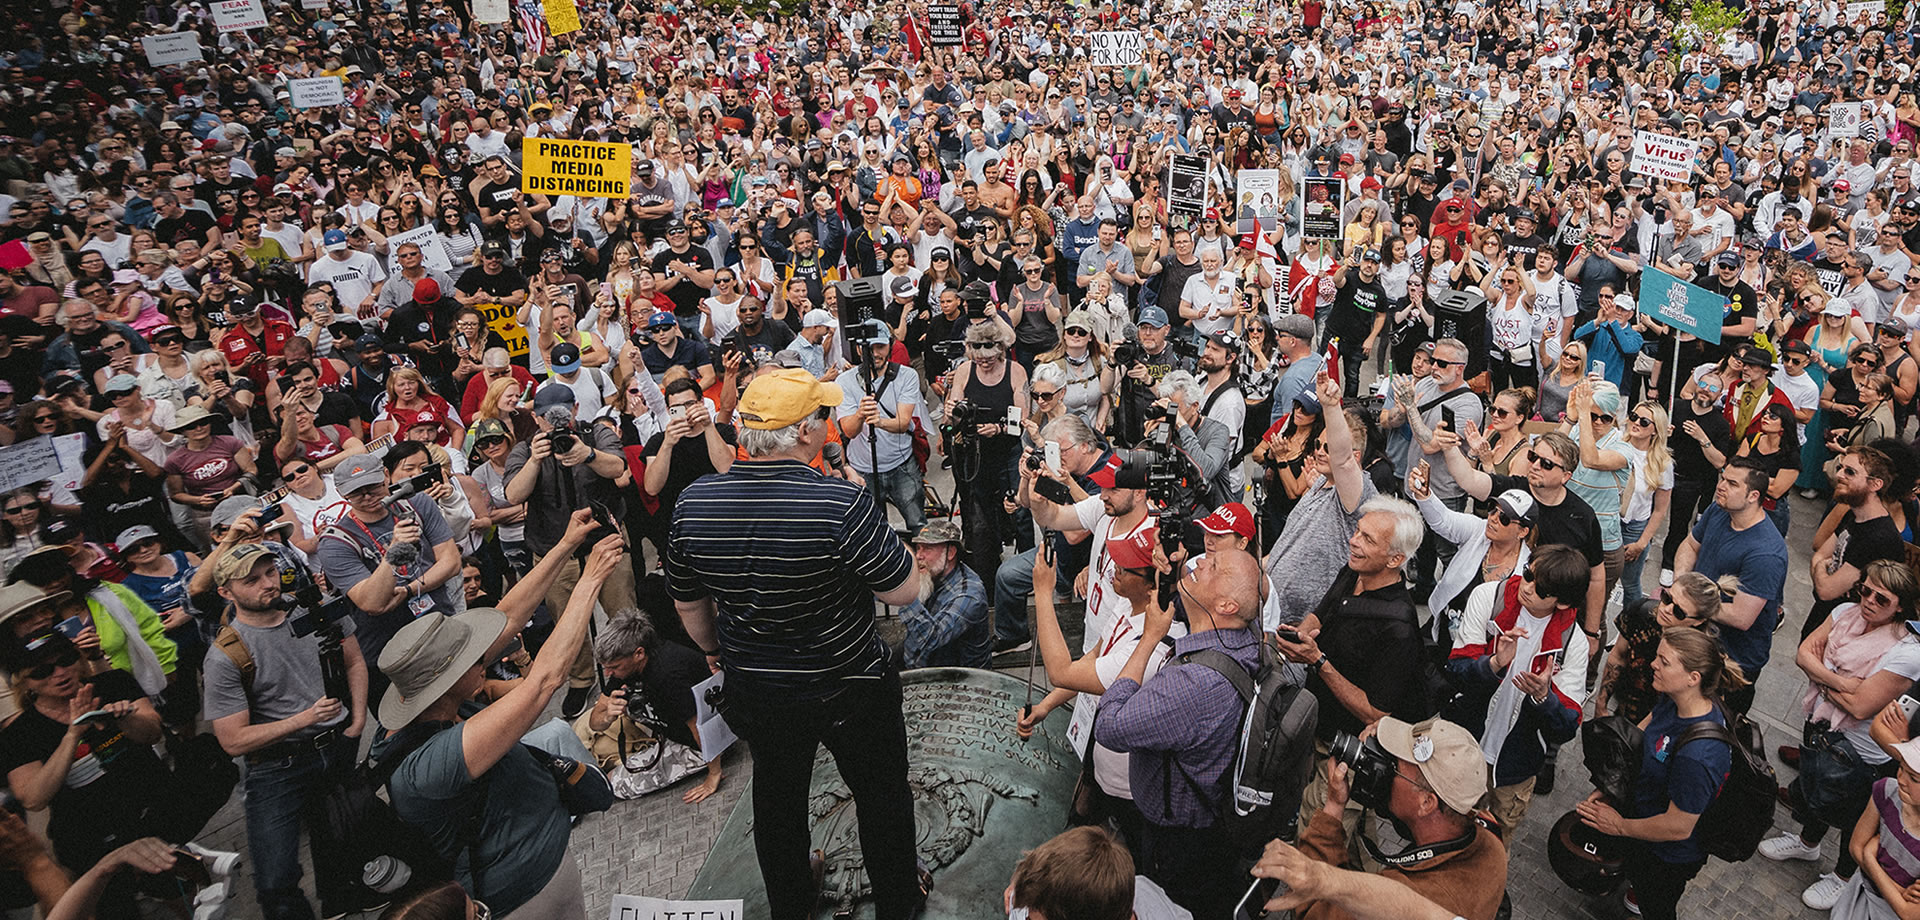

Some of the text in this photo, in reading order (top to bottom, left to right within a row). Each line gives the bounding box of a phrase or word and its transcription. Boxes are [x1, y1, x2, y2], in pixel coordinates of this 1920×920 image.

[222, 0, 250, 9] FEAR
[219, 20, 265, 31] TERRORISTS
[1092, 33, 1140, 48] NO VAX
[1092, 49, 1142, 65] FOR KIDS
[301, 91, 338, 99] DEMOCRACY
[1644, 134, 1658, 142] it's
[1676, 139, 1690, 149] the
[540, 143, 617, 161] PRACTICE
[1635, 154, 1646, 162] they
[1645, 143, 1686, 162] Virus
[551, 161, 604, 177] MEDIA
[1640, 164, 1679, 179] It's You!
[529, 177, 624, 194] DISTANCING
[333, 272, 359, 283] PUMA
[1673, 282, 1686, 293] We
[1668, 289, 1689, 304] Want
[1669, 299, 1684, 311] Our
[1659, 304, 1697, 327] Freedom!
[1496, 319, 1521, 329] JUST
[1496, 331, 1520, 339] SAY
[194, 462, 225, 480] Pepper
[264, 492, 278, 504] TO
[918, 711, 1021, 737] EMPEROR
[931, 726, 1025, 751] MAJESTY
[921, 735, 1042, 772] WAS PLACED
[923, 747, 970, 760] THIS
[1416, 851, 1434, 861] EOS
